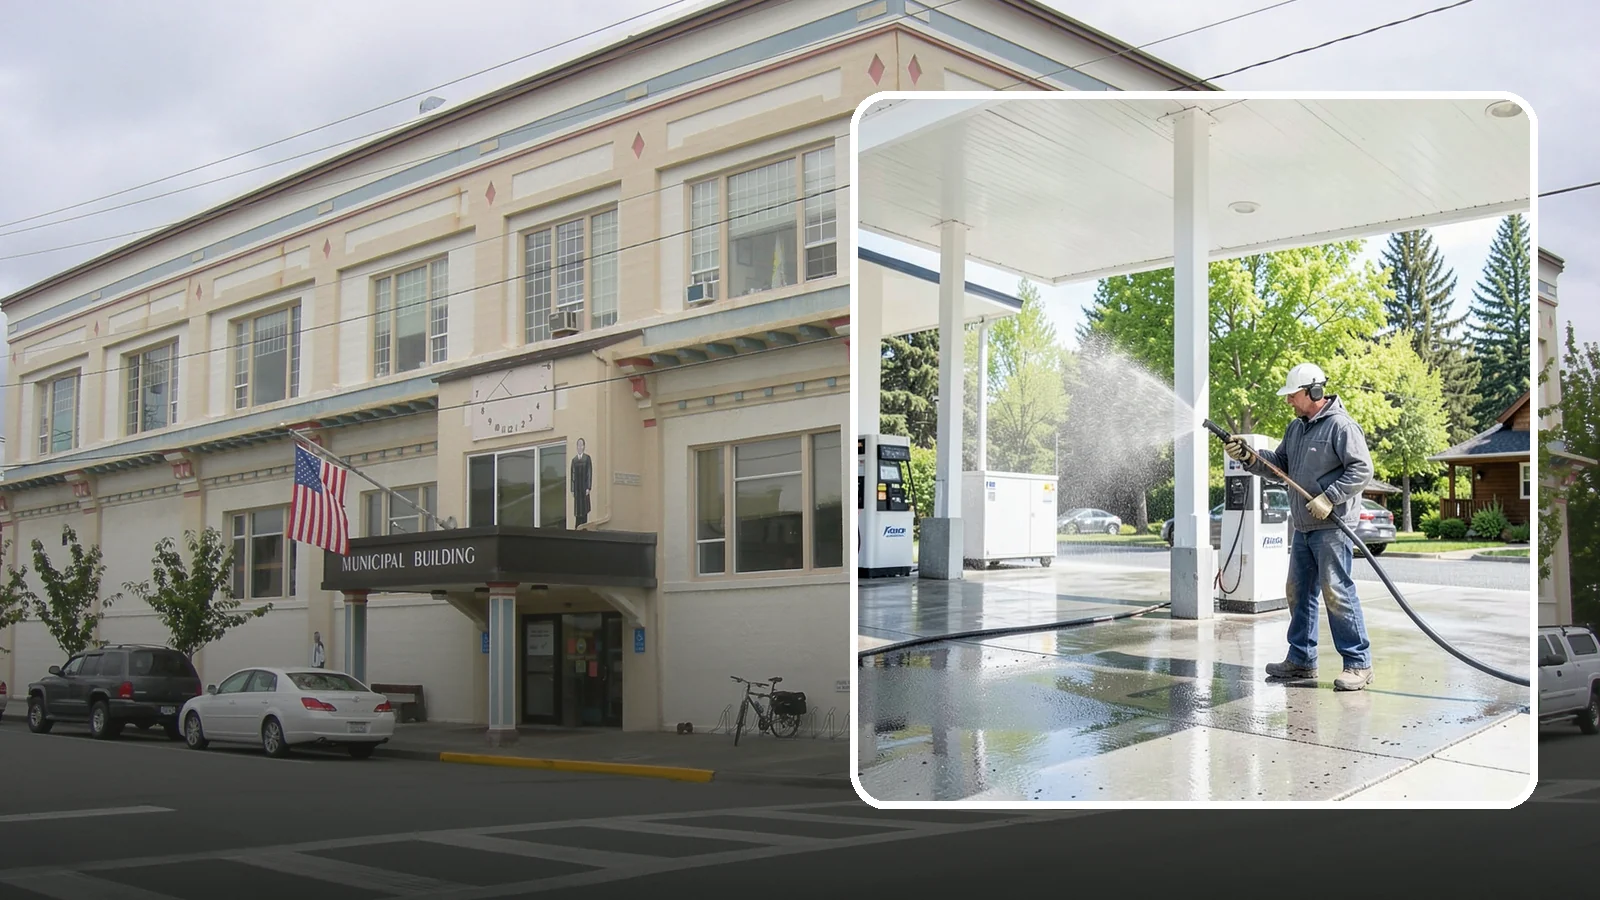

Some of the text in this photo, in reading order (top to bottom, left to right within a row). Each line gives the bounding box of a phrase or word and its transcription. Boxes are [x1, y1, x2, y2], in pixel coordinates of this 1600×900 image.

[536, 402, 540, 410] 4
[480, 407, 485, 415] 8
[487, 418, 493, 426] 9
[528, 414, 533, 422] 3
[494, 424, 500, 432] 10
[521, 420, 526, 428] 2
[507, 425, 514, 433] 12
[342, 546, 475, 572] MUNICIPAL BUILDING
